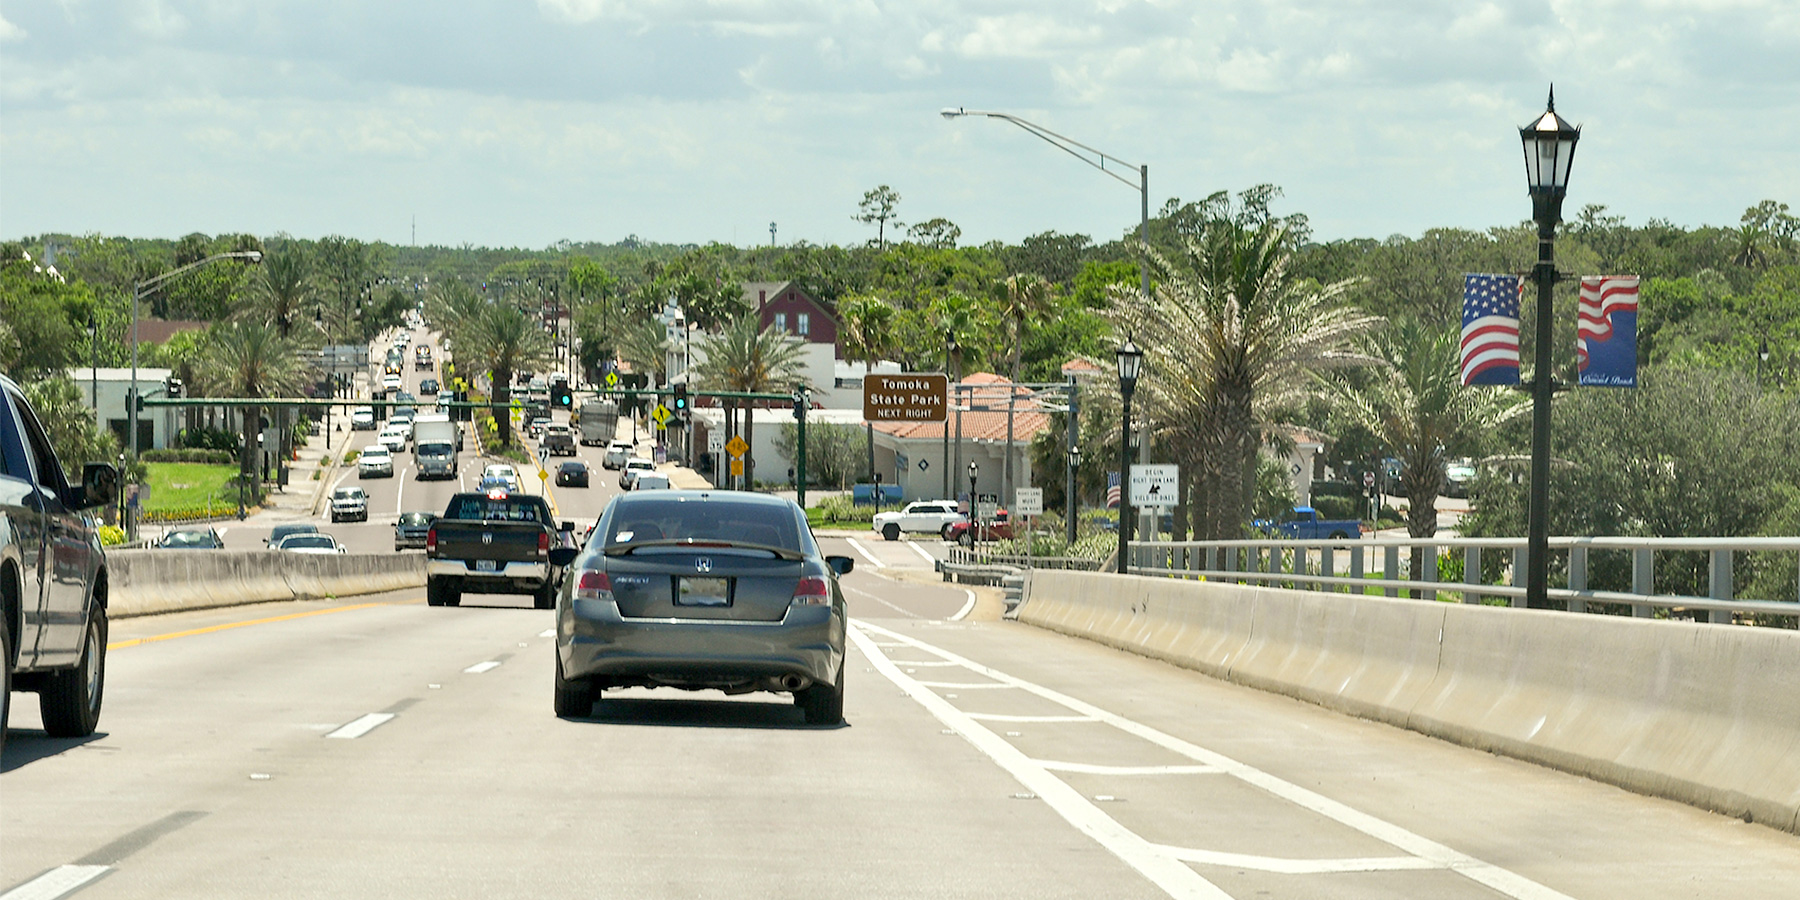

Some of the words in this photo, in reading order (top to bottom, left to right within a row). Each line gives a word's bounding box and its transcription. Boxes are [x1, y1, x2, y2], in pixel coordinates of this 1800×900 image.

[881, 378, 930, 390] Tomoka
[870, 393, 906, 405] State
[911, 393, 941, 405] Park
[877, 408, 901, 418] NEXT
[905, 408, 932, 418] RIGHT
